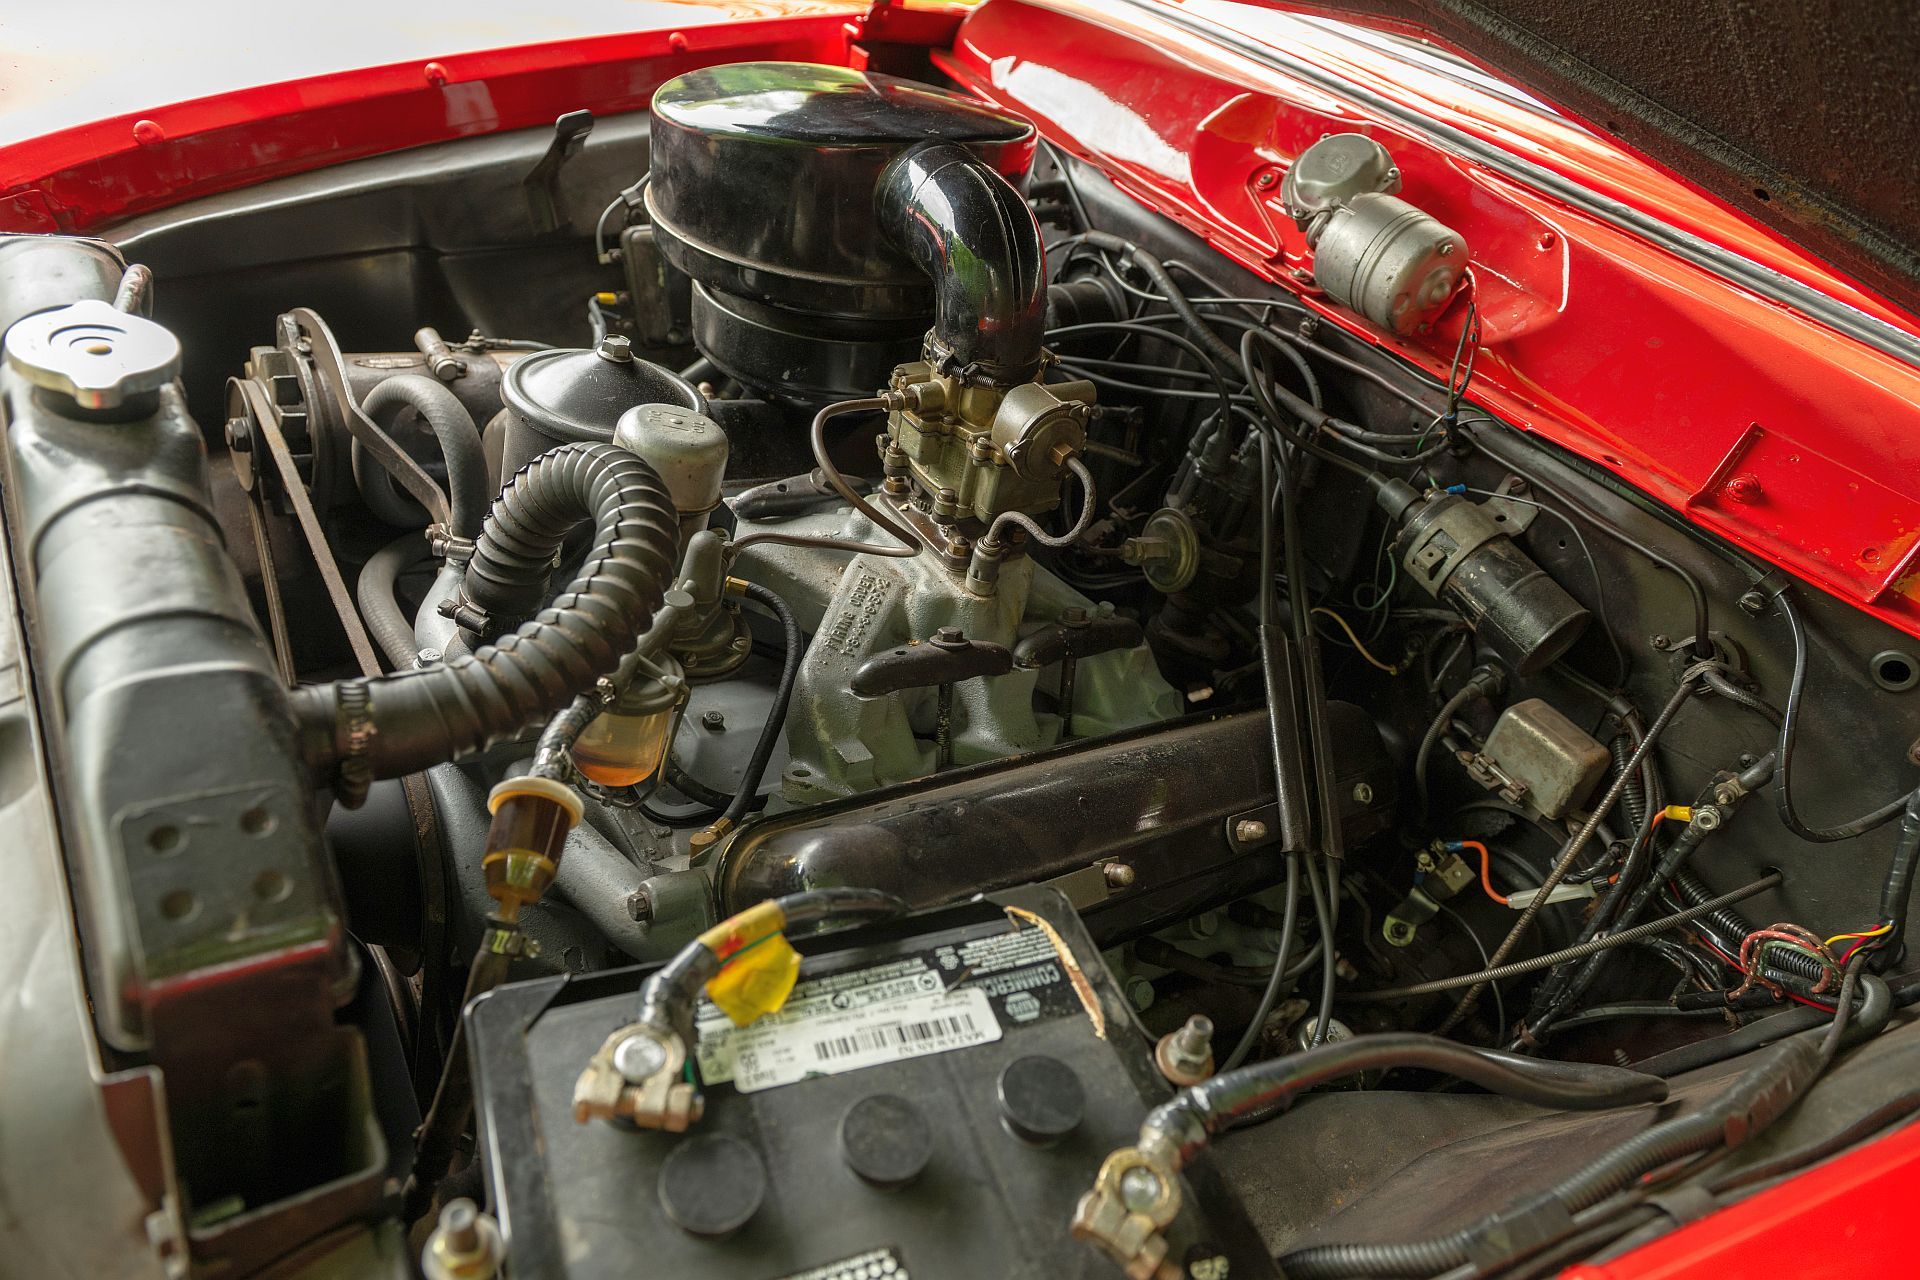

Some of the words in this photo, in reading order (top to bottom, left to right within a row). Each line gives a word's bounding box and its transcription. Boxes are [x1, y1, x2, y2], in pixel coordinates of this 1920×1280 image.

[825, 611, 857, 651] FIRING
[849, 574, 876, 607] ORDER
[965, 964, 1061, 998] COMMERC
